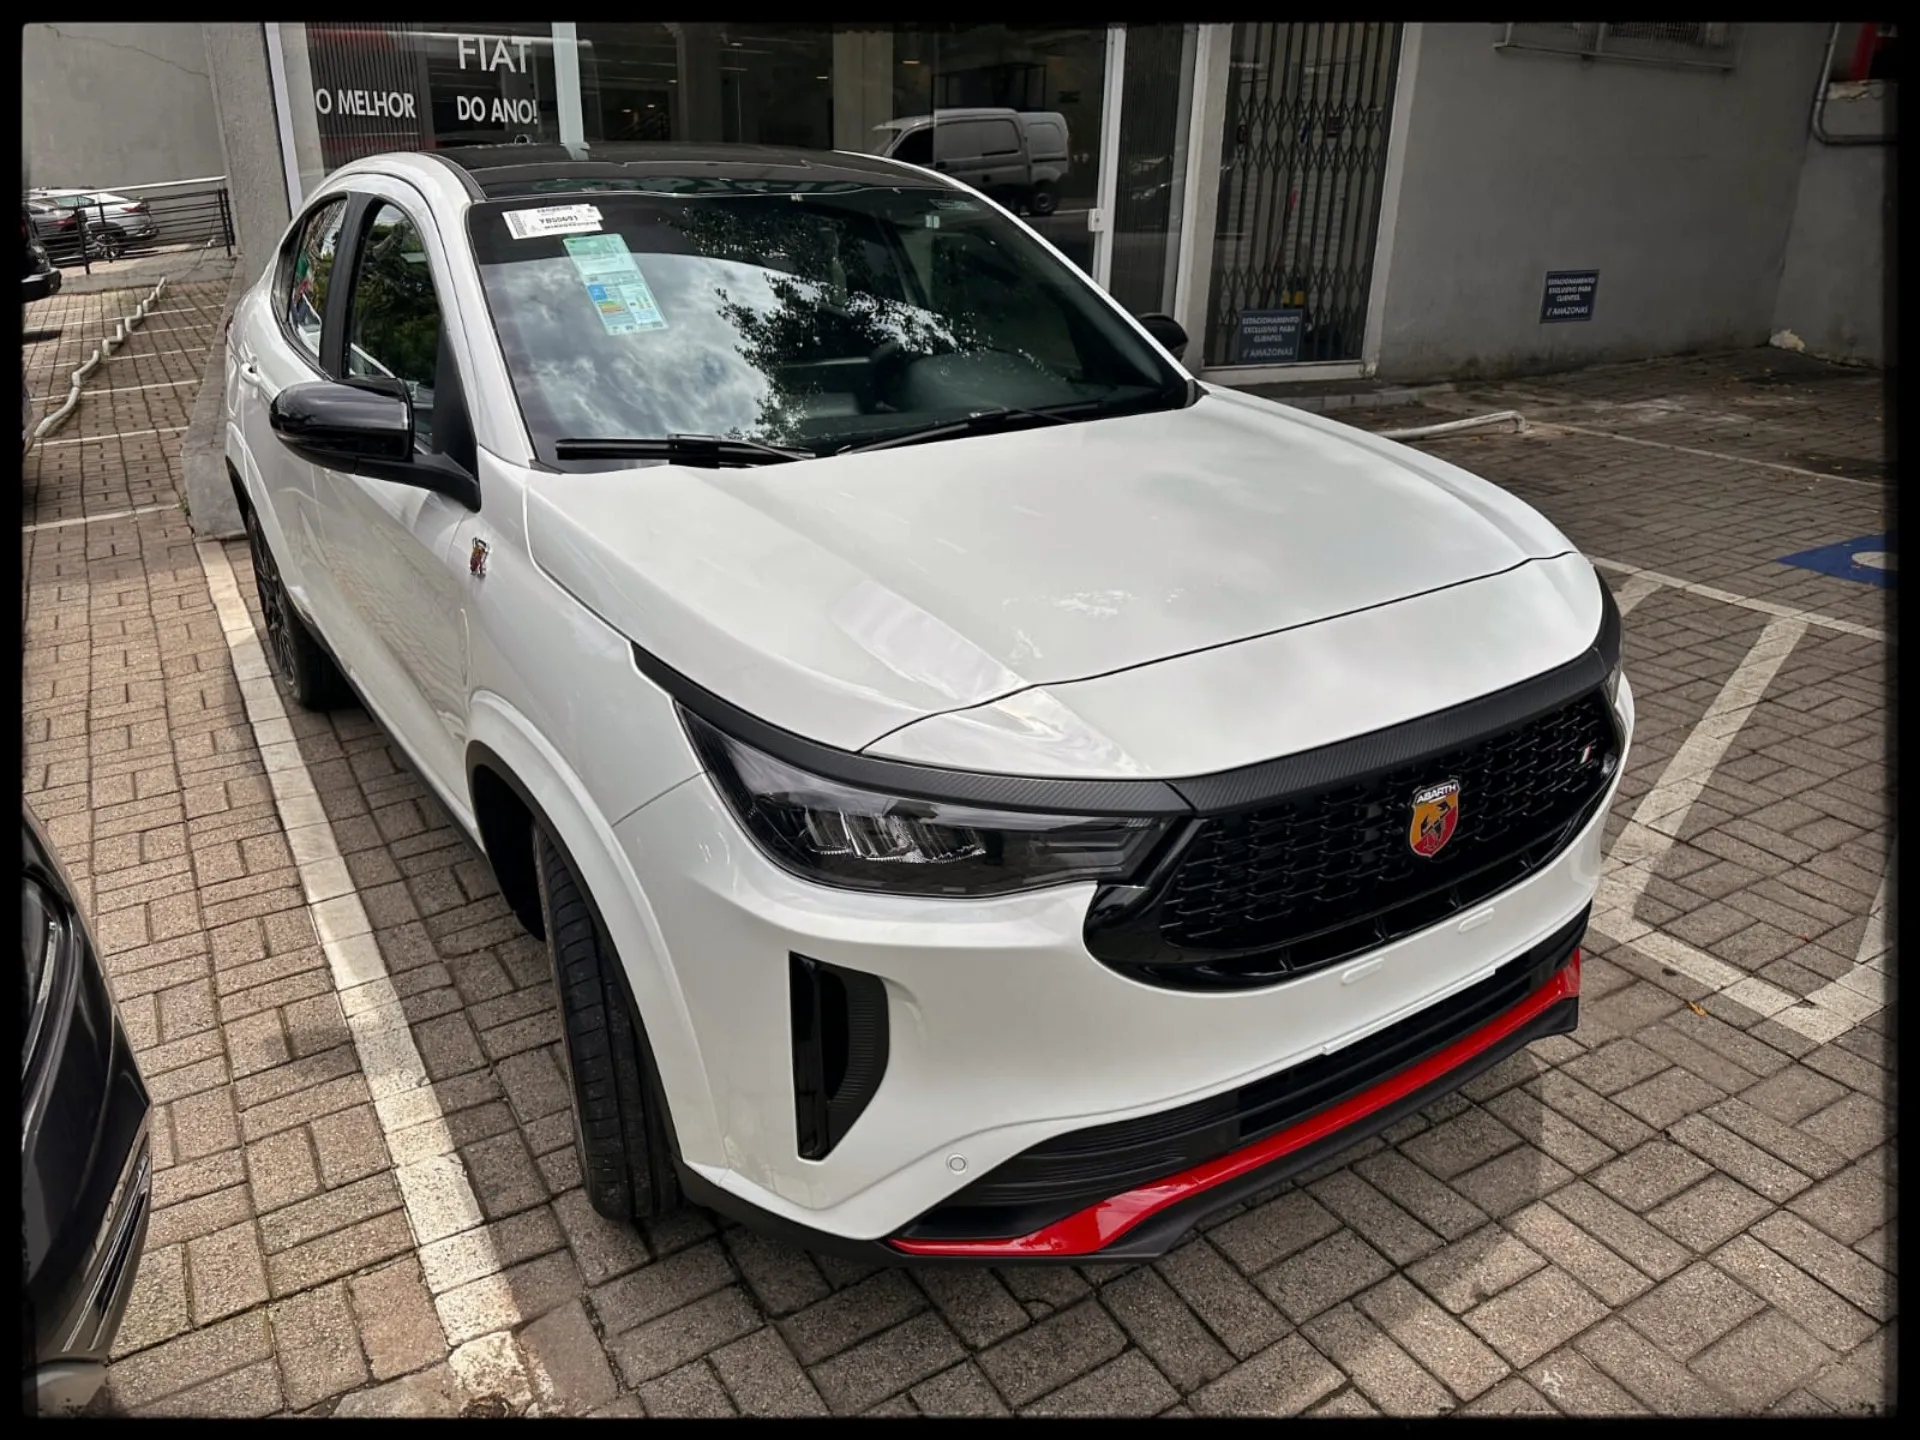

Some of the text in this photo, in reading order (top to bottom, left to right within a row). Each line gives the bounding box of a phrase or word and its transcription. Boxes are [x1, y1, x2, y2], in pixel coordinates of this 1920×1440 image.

[457, 36, 532, 73] FIAT
[316, 88, 416, 118] O MELHOR
[457, 95, 538, 125] DO ANO!
[1416, 784, 1456, 803] ABARTH
